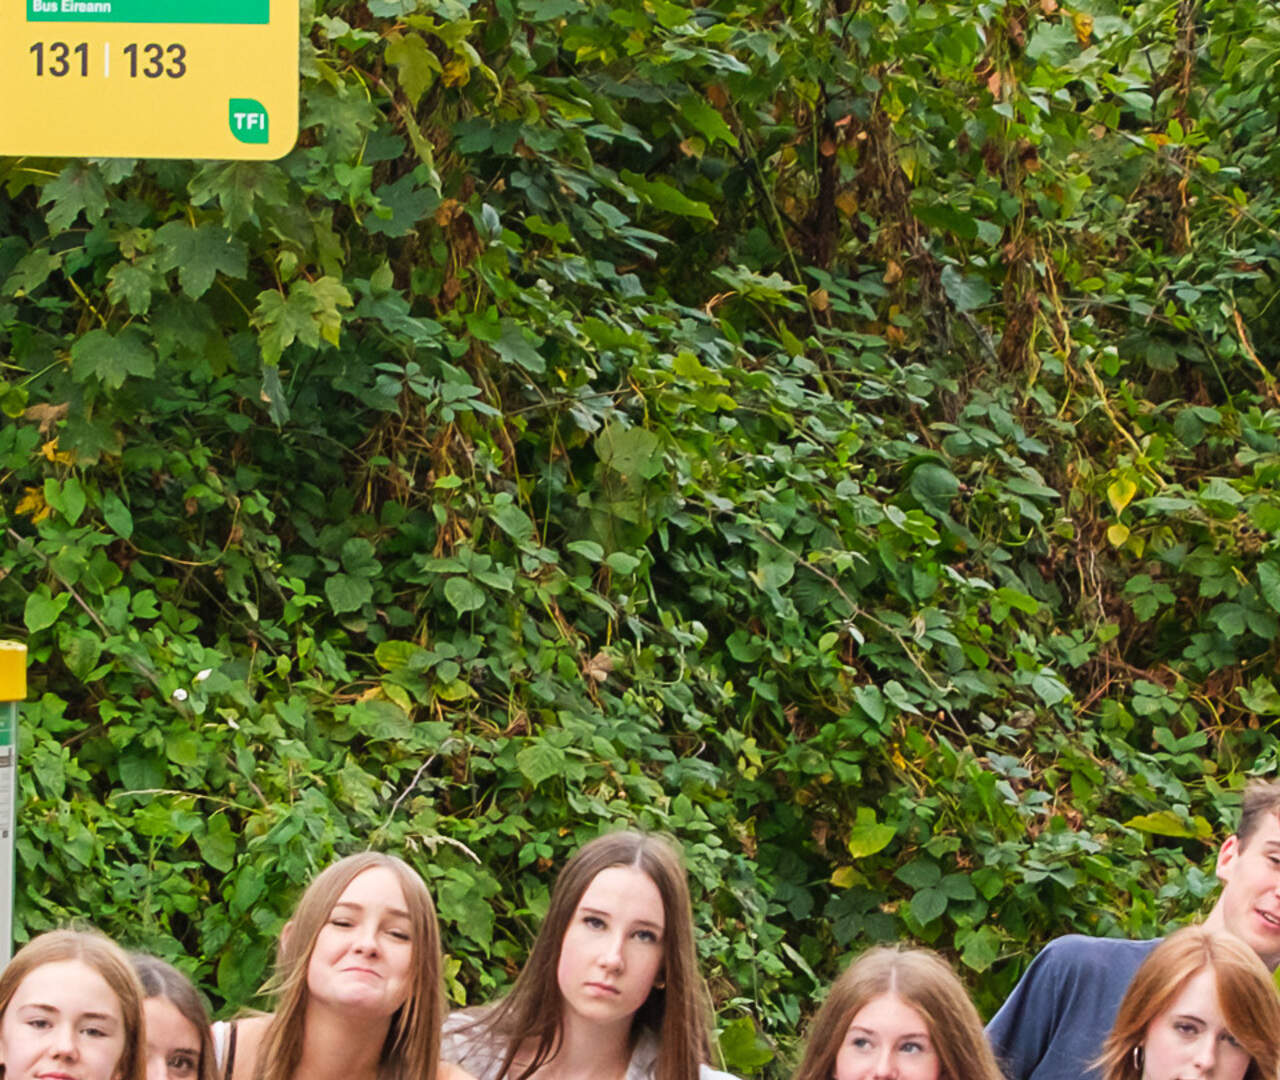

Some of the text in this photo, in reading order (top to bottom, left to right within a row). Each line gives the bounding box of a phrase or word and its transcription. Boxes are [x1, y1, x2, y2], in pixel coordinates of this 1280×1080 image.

[32, 0, 59, 13] Bus
[29, 41, 187, 79] 131 133
[233, 112, 265, 130] TFI
